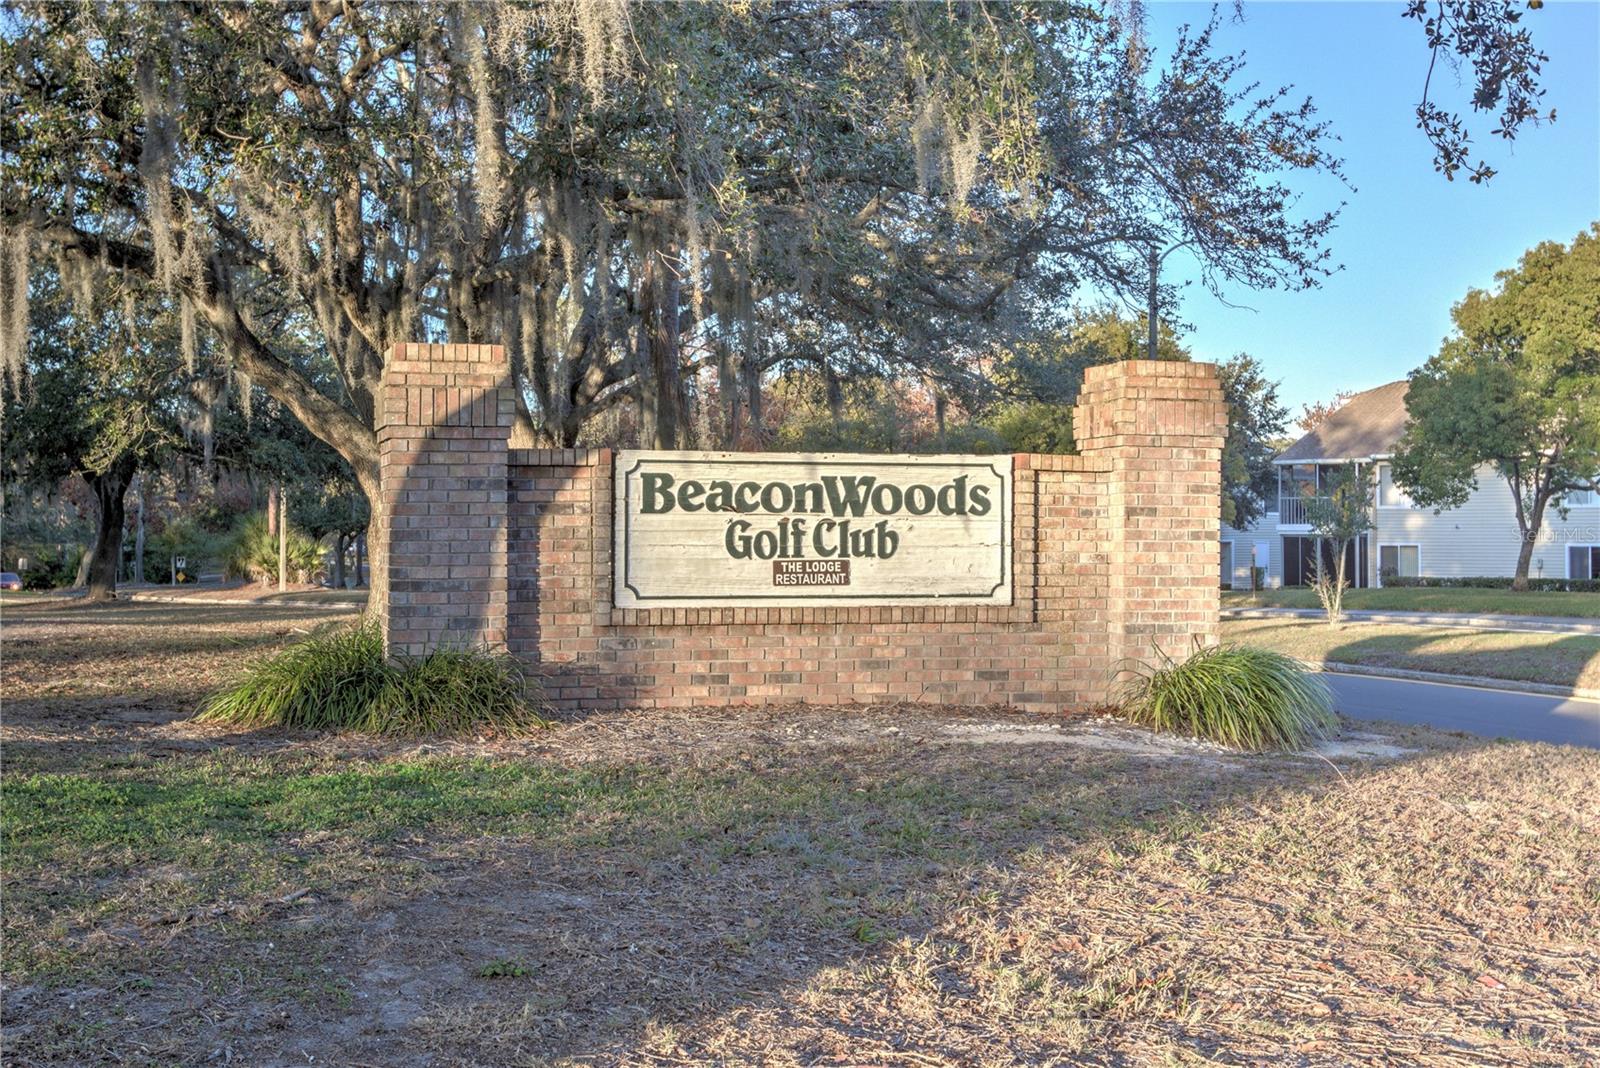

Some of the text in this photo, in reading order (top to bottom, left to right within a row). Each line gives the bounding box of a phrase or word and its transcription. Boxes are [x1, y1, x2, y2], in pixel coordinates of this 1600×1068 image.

[725, 518, 899, 560] Golf Club
[780, 561, 842, 573] THE LODGE
[775, 573, 846, 585] RESTAURANT
